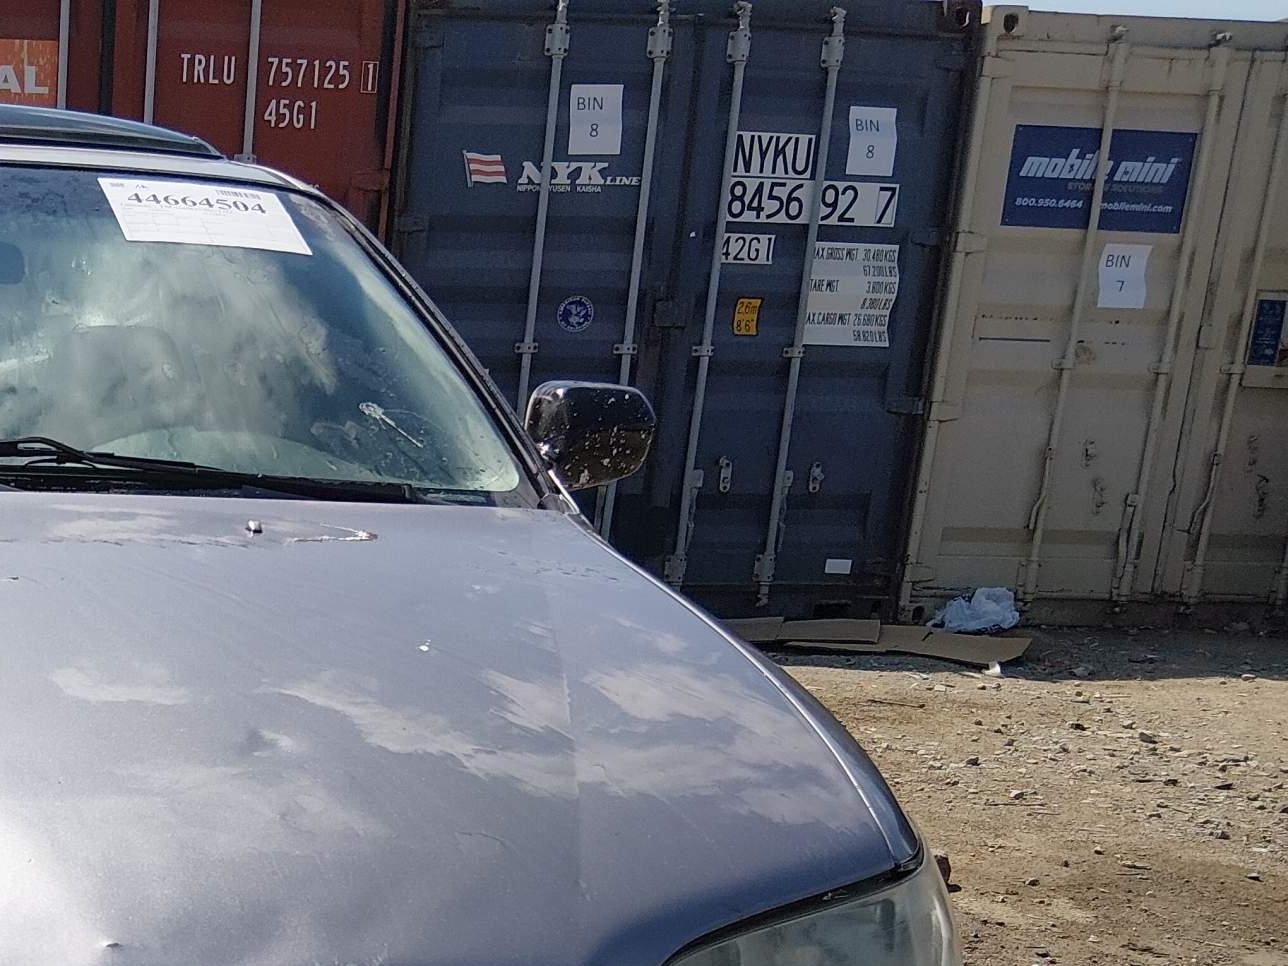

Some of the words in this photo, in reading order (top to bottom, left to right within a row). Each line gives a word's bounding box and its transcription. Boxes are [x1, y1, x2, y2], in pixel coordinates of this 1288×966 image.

[180, 53, 236, 85] TRLU
[267, 57, 350, 89] 757125
[263, 99, 318, 129] 45G1
[576, 96, 604, 111] BIN
[589, 123, 599, 138] 8
[855, 117, 881, 133] BIN
[732, 133, 814, 176] NYKU
[865, 144, 875, 159] 8
[518, 161, 609, 185] NYK
[605, 176, 642, 185] LINE
[1113, 156, 1178, 184] mini
[576, 185, 602, 193] KAISHA
[127, 192, 267, 214] 44664504
[875, 186, 897, 225] 7
[722, 235, 773, 262] 42G1
[1104, 254, 1132, 268] BIN
[1115, 280, 1125, 292] 7
